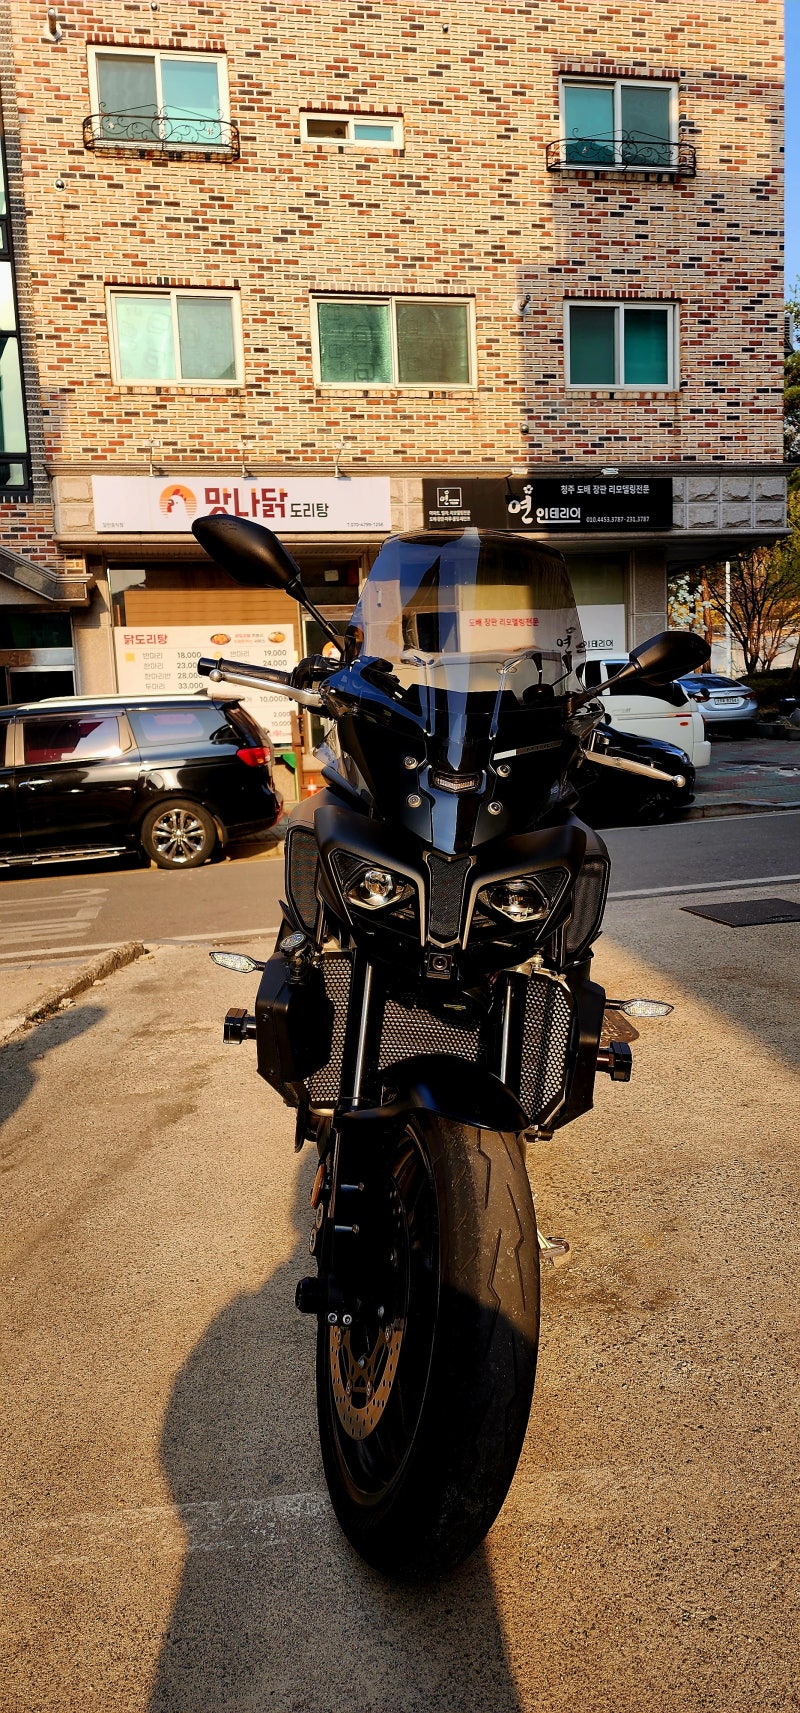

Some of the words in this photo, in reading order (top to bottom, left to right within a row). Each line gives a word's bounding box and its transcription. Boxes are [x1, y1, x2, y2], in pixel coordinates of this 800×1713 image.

[560, 484, 575, 495] 청주
[576, 484, 591, 495] 도배
[592, 484, 607, 495] 장판
[608, 484, 650, 495] 리모델링전문
[204, 487, 289, 518] 맛나닭
[290, 502, 330, 518] 도리탕
[507, 493, 533, 525] 연
[536, 507, 581, 524] 인테리어
[468, 617, 482, 628] 도배
[483, 617, 498, 627] 장판
[499, 617, 540, 627] 리모델링전문
[123, 633, 168, 646] 닭도리탕
[142, 652, 163, 660] 반마리
[177, 651, 202, 660] 18,000
[230, 650, 250, 658] 반마리
[263, 649, 287, 657] 19,000
[143, 662, 164, 670] 한마리
[176, 662, 197, 670] 23,00
[263, 659, 288, 668] 24,000
[144, 672, 171, 680] 한마리반
[145, 682, 166, 690] 두마리
[178, 682, 204, 690] 33,000
